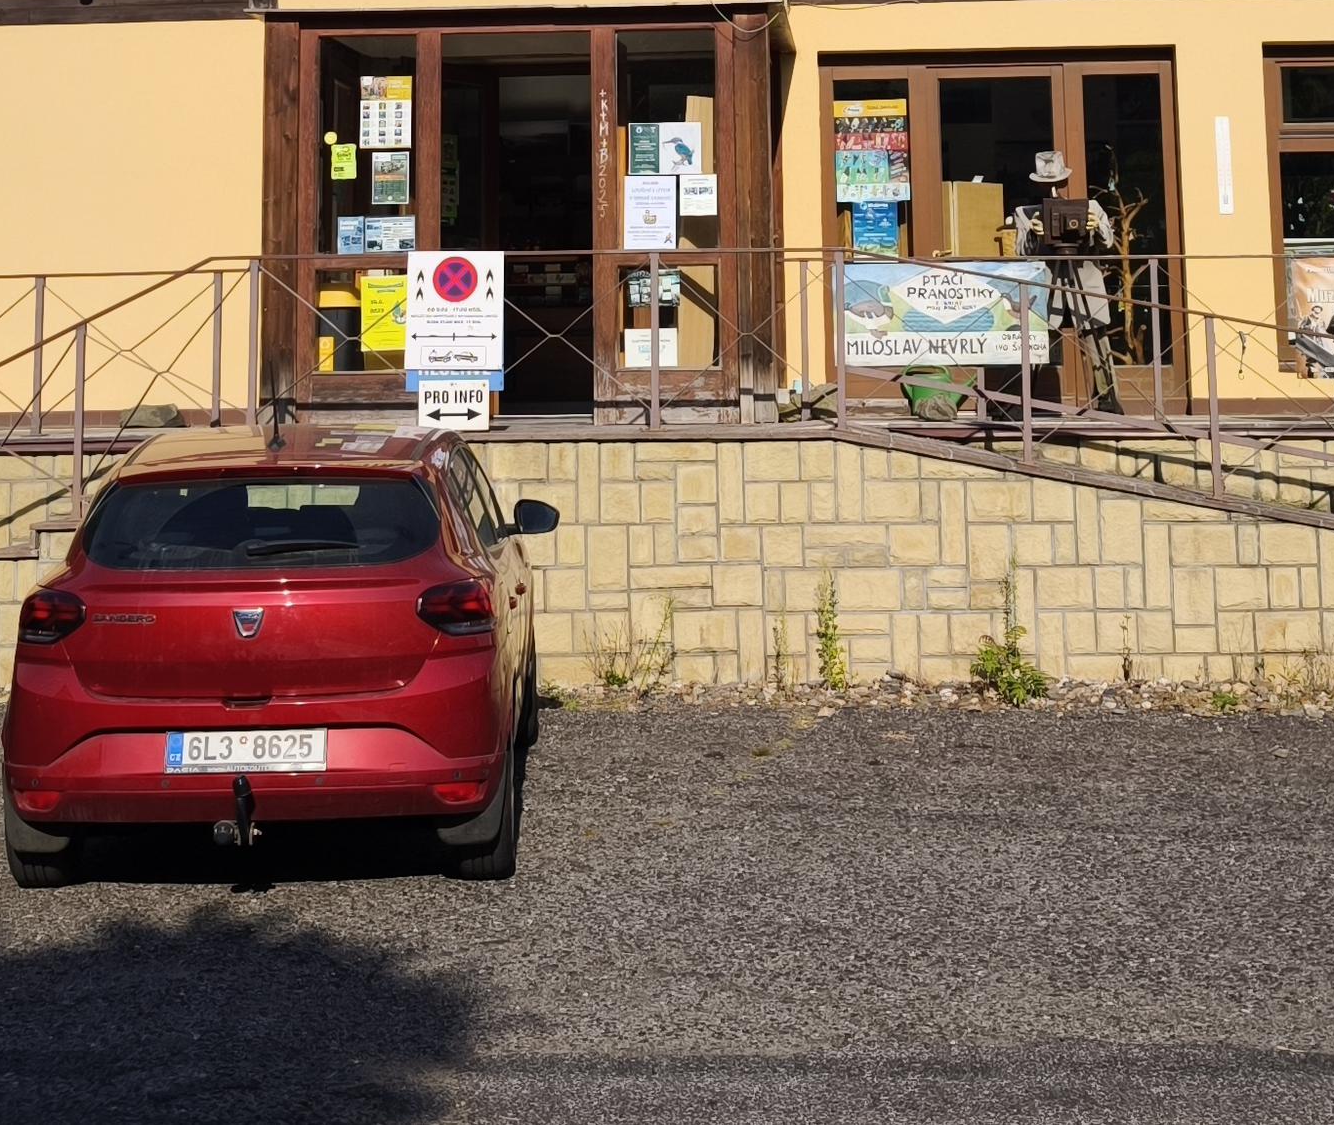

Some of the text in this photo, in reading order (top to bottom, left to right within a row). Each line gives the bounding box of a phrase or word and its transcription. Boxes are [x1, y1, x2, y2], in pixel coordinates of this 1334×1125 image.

[906, 286, 995, 300] PRANOSTIKY
[847, 333, 988, 356] MILOSLAV NEVRLÝ
[424, 389, 483, 404] PRO INFO
[188, 734, 314, 761] 6L3 8625
[169, 752, 182, 762] CZ
